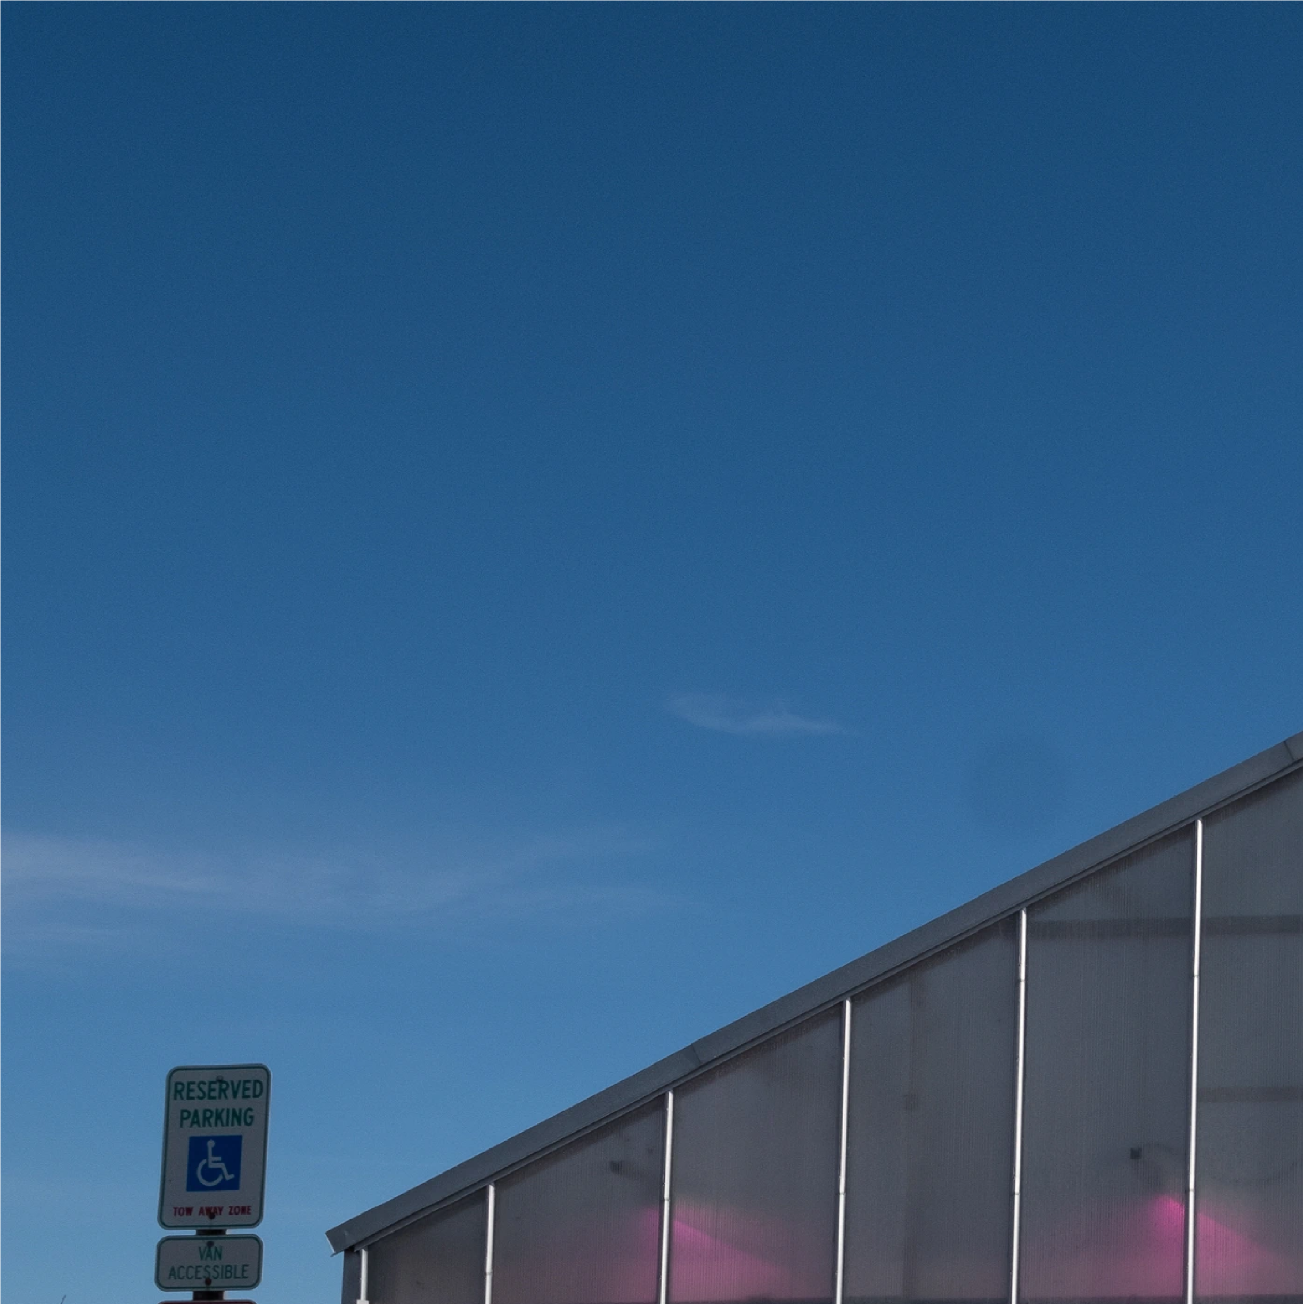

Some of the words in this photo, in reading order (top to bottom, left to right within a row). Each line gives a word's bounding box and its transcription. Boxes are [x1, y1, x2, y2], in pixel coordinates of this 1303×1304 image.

[174, 1080, 263, 1100] RESERVED
[180, 1107, 254, 1128] PARKING
[173, 1206, 194, 1216] TOW
[199, 1206, 224, 1216] AWAY
[229, 1205, 252, 1216] ZONE
[199, 1246, 223, 1261] VAN
[168, 1264, 249, 1280] ACCESSIBLE
